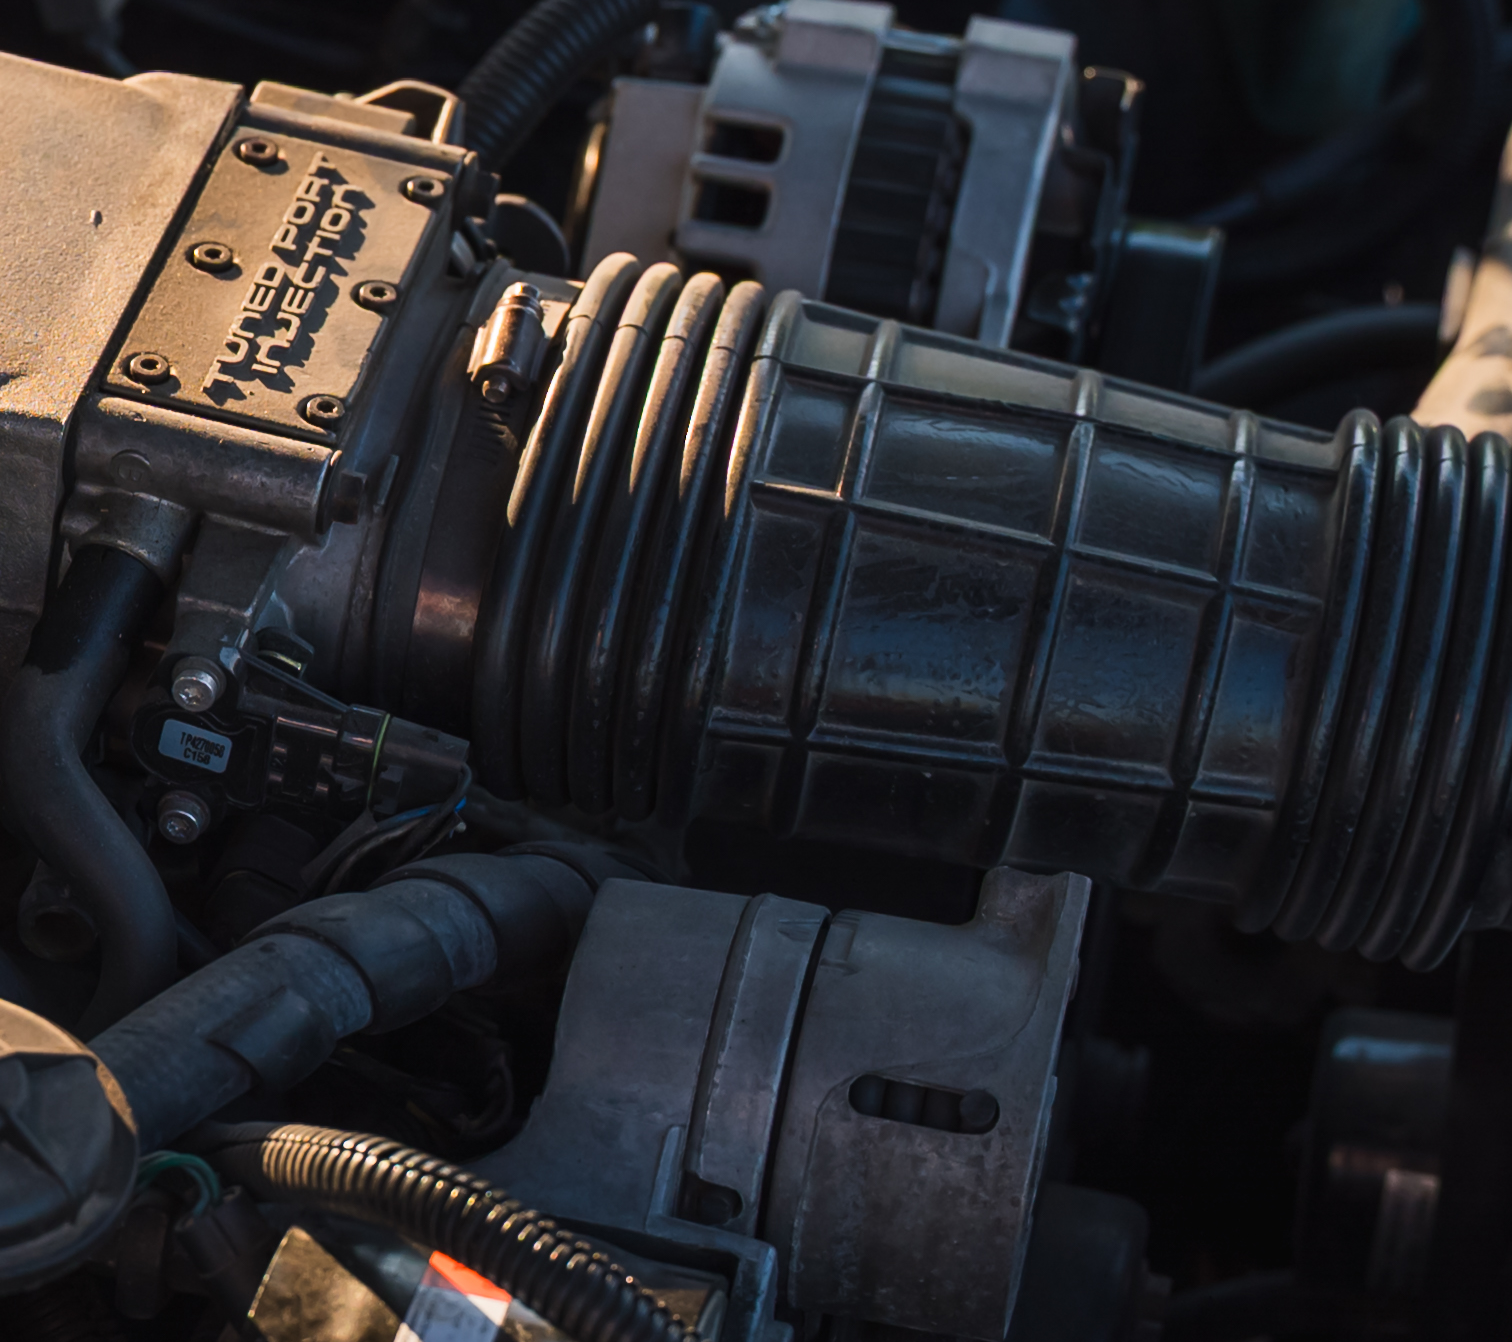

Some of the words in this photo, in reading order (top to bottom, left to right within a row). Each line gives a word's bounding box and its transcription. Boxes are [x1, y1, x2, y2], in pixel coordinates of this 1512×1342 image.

[202, 262, 284, 393] TUNED
[270, 152, 337, 253] PORT
[252, 183, 364, 374] INJECTION
